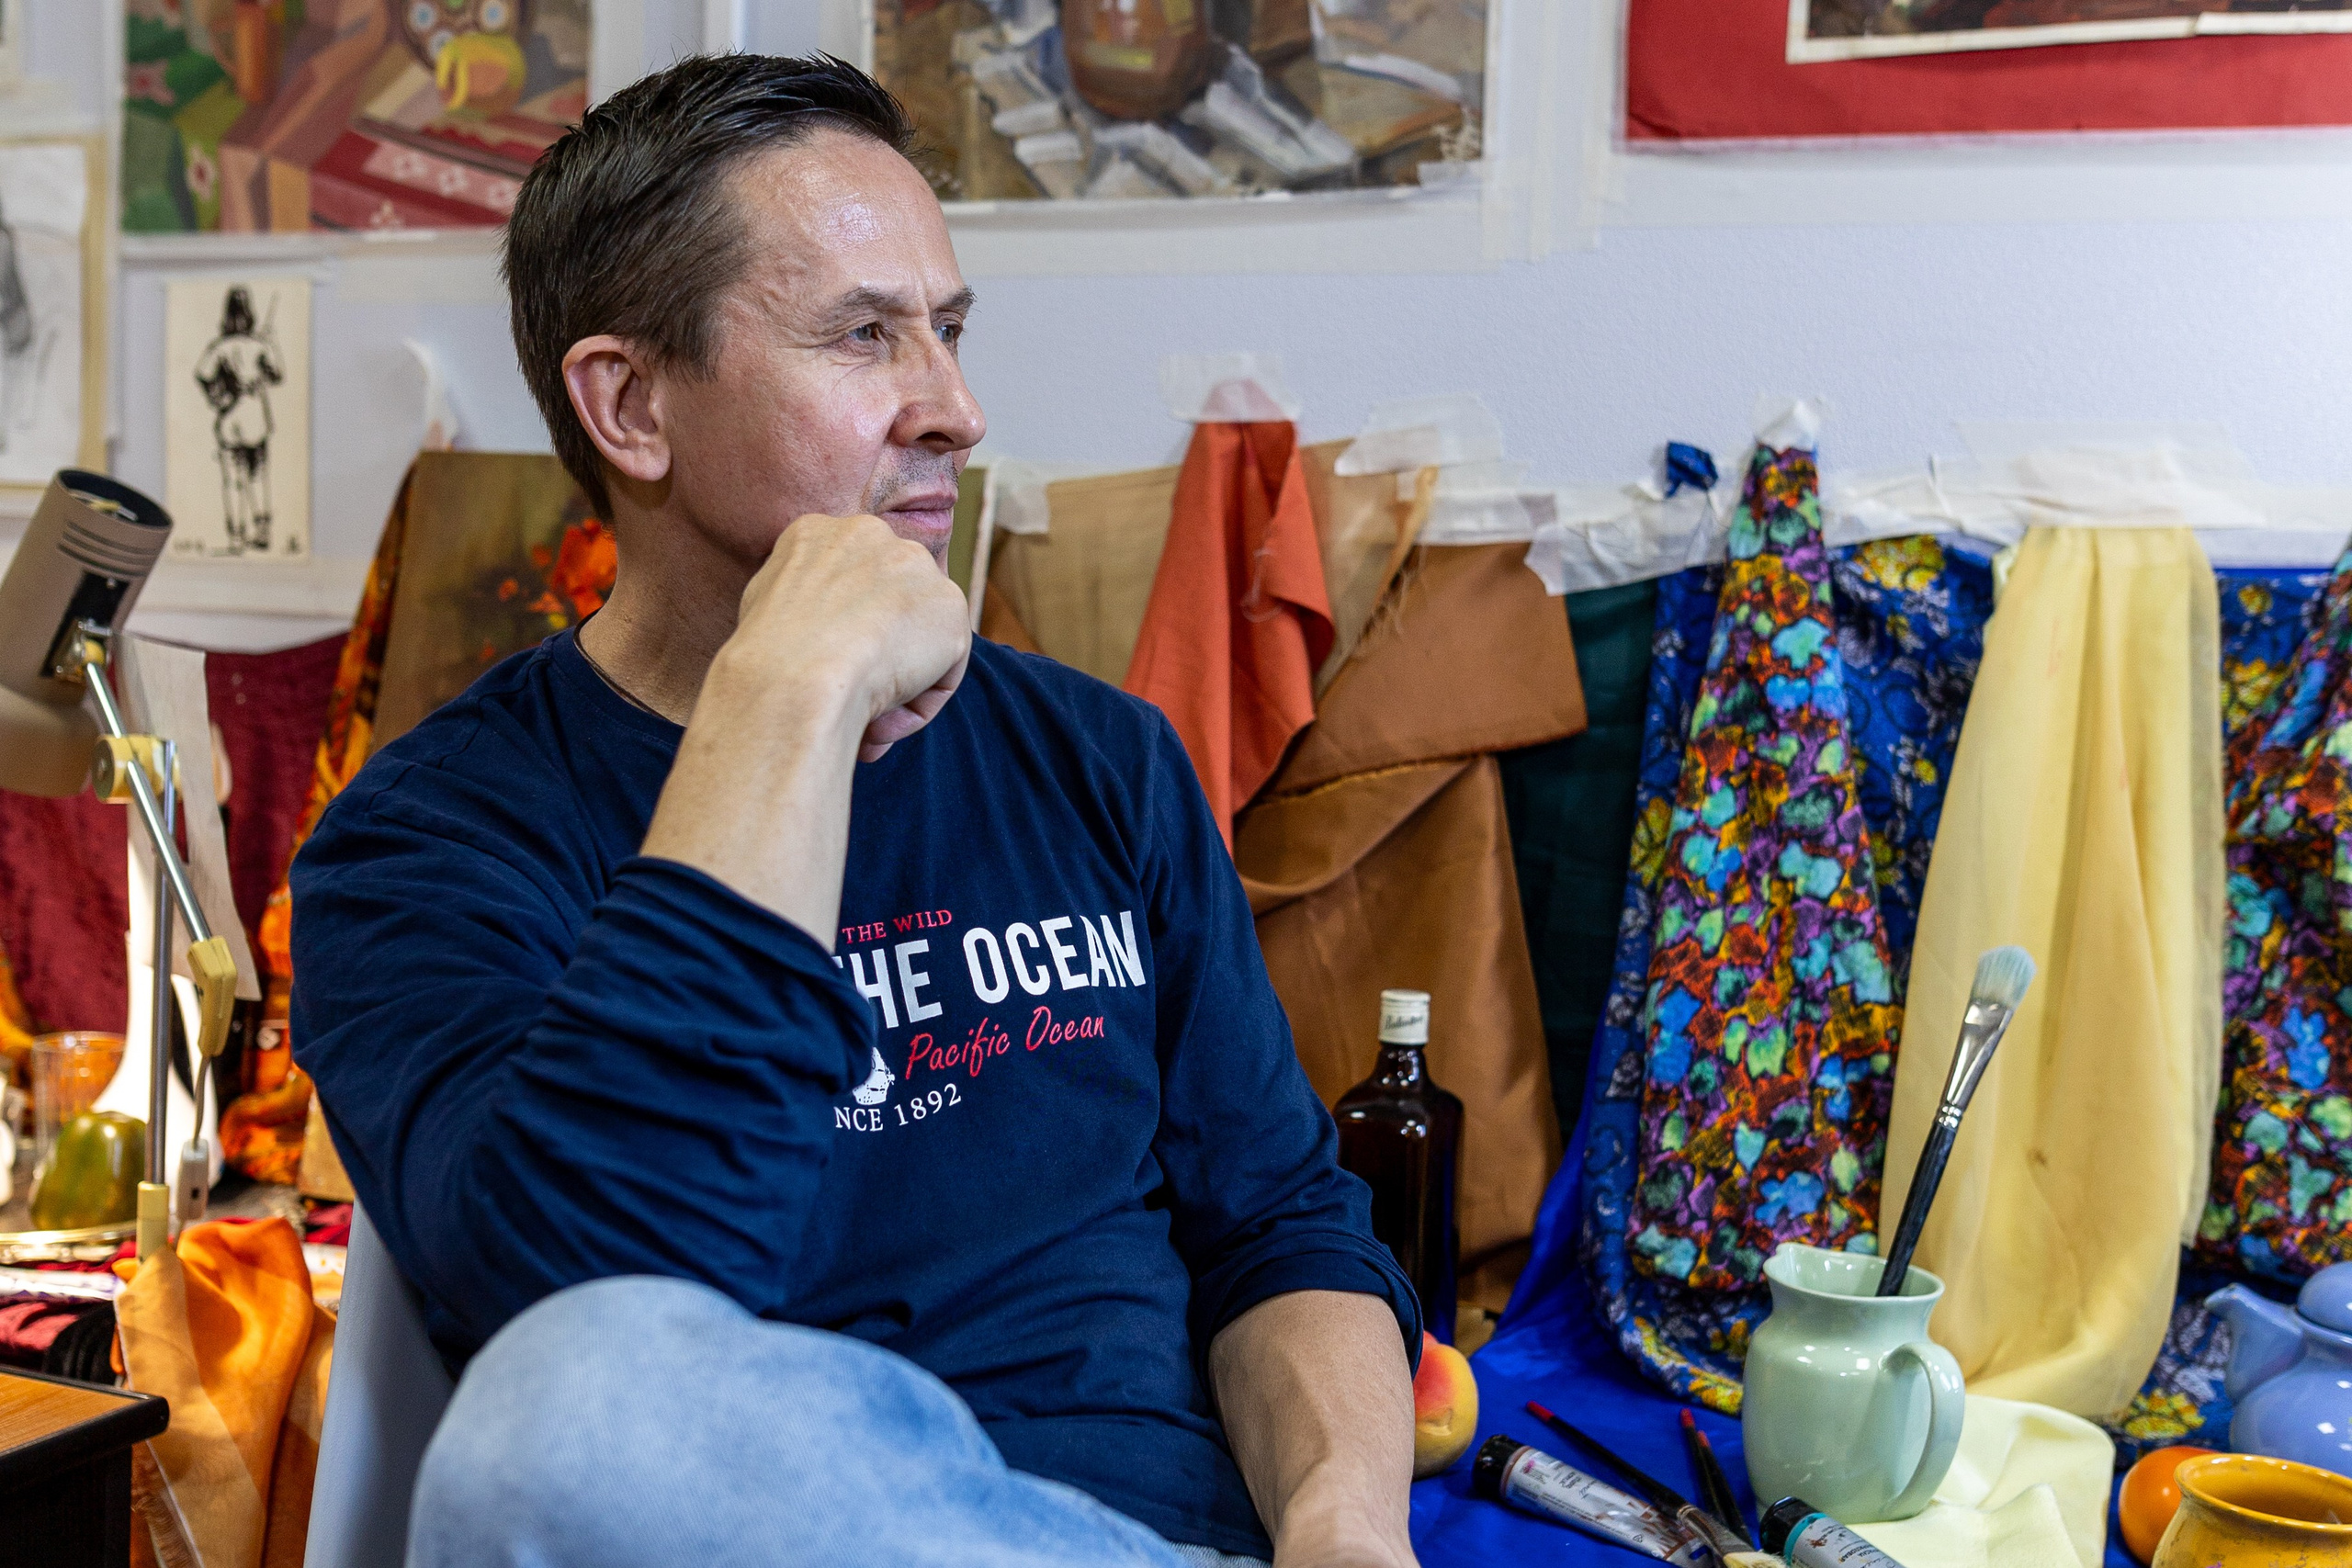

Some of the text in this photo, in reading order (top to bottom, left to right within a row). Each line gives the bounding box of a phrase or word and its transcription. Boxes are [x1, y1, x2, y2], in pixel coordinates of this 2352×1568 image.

[842, 909, 953, 944] THE WILD
[831, 910, 1147, 1029] HE OCEAN
[904, 1005, 1105, 1080] Pacific Ocean
[833, 1083, 962, 1132] NCE 1892
